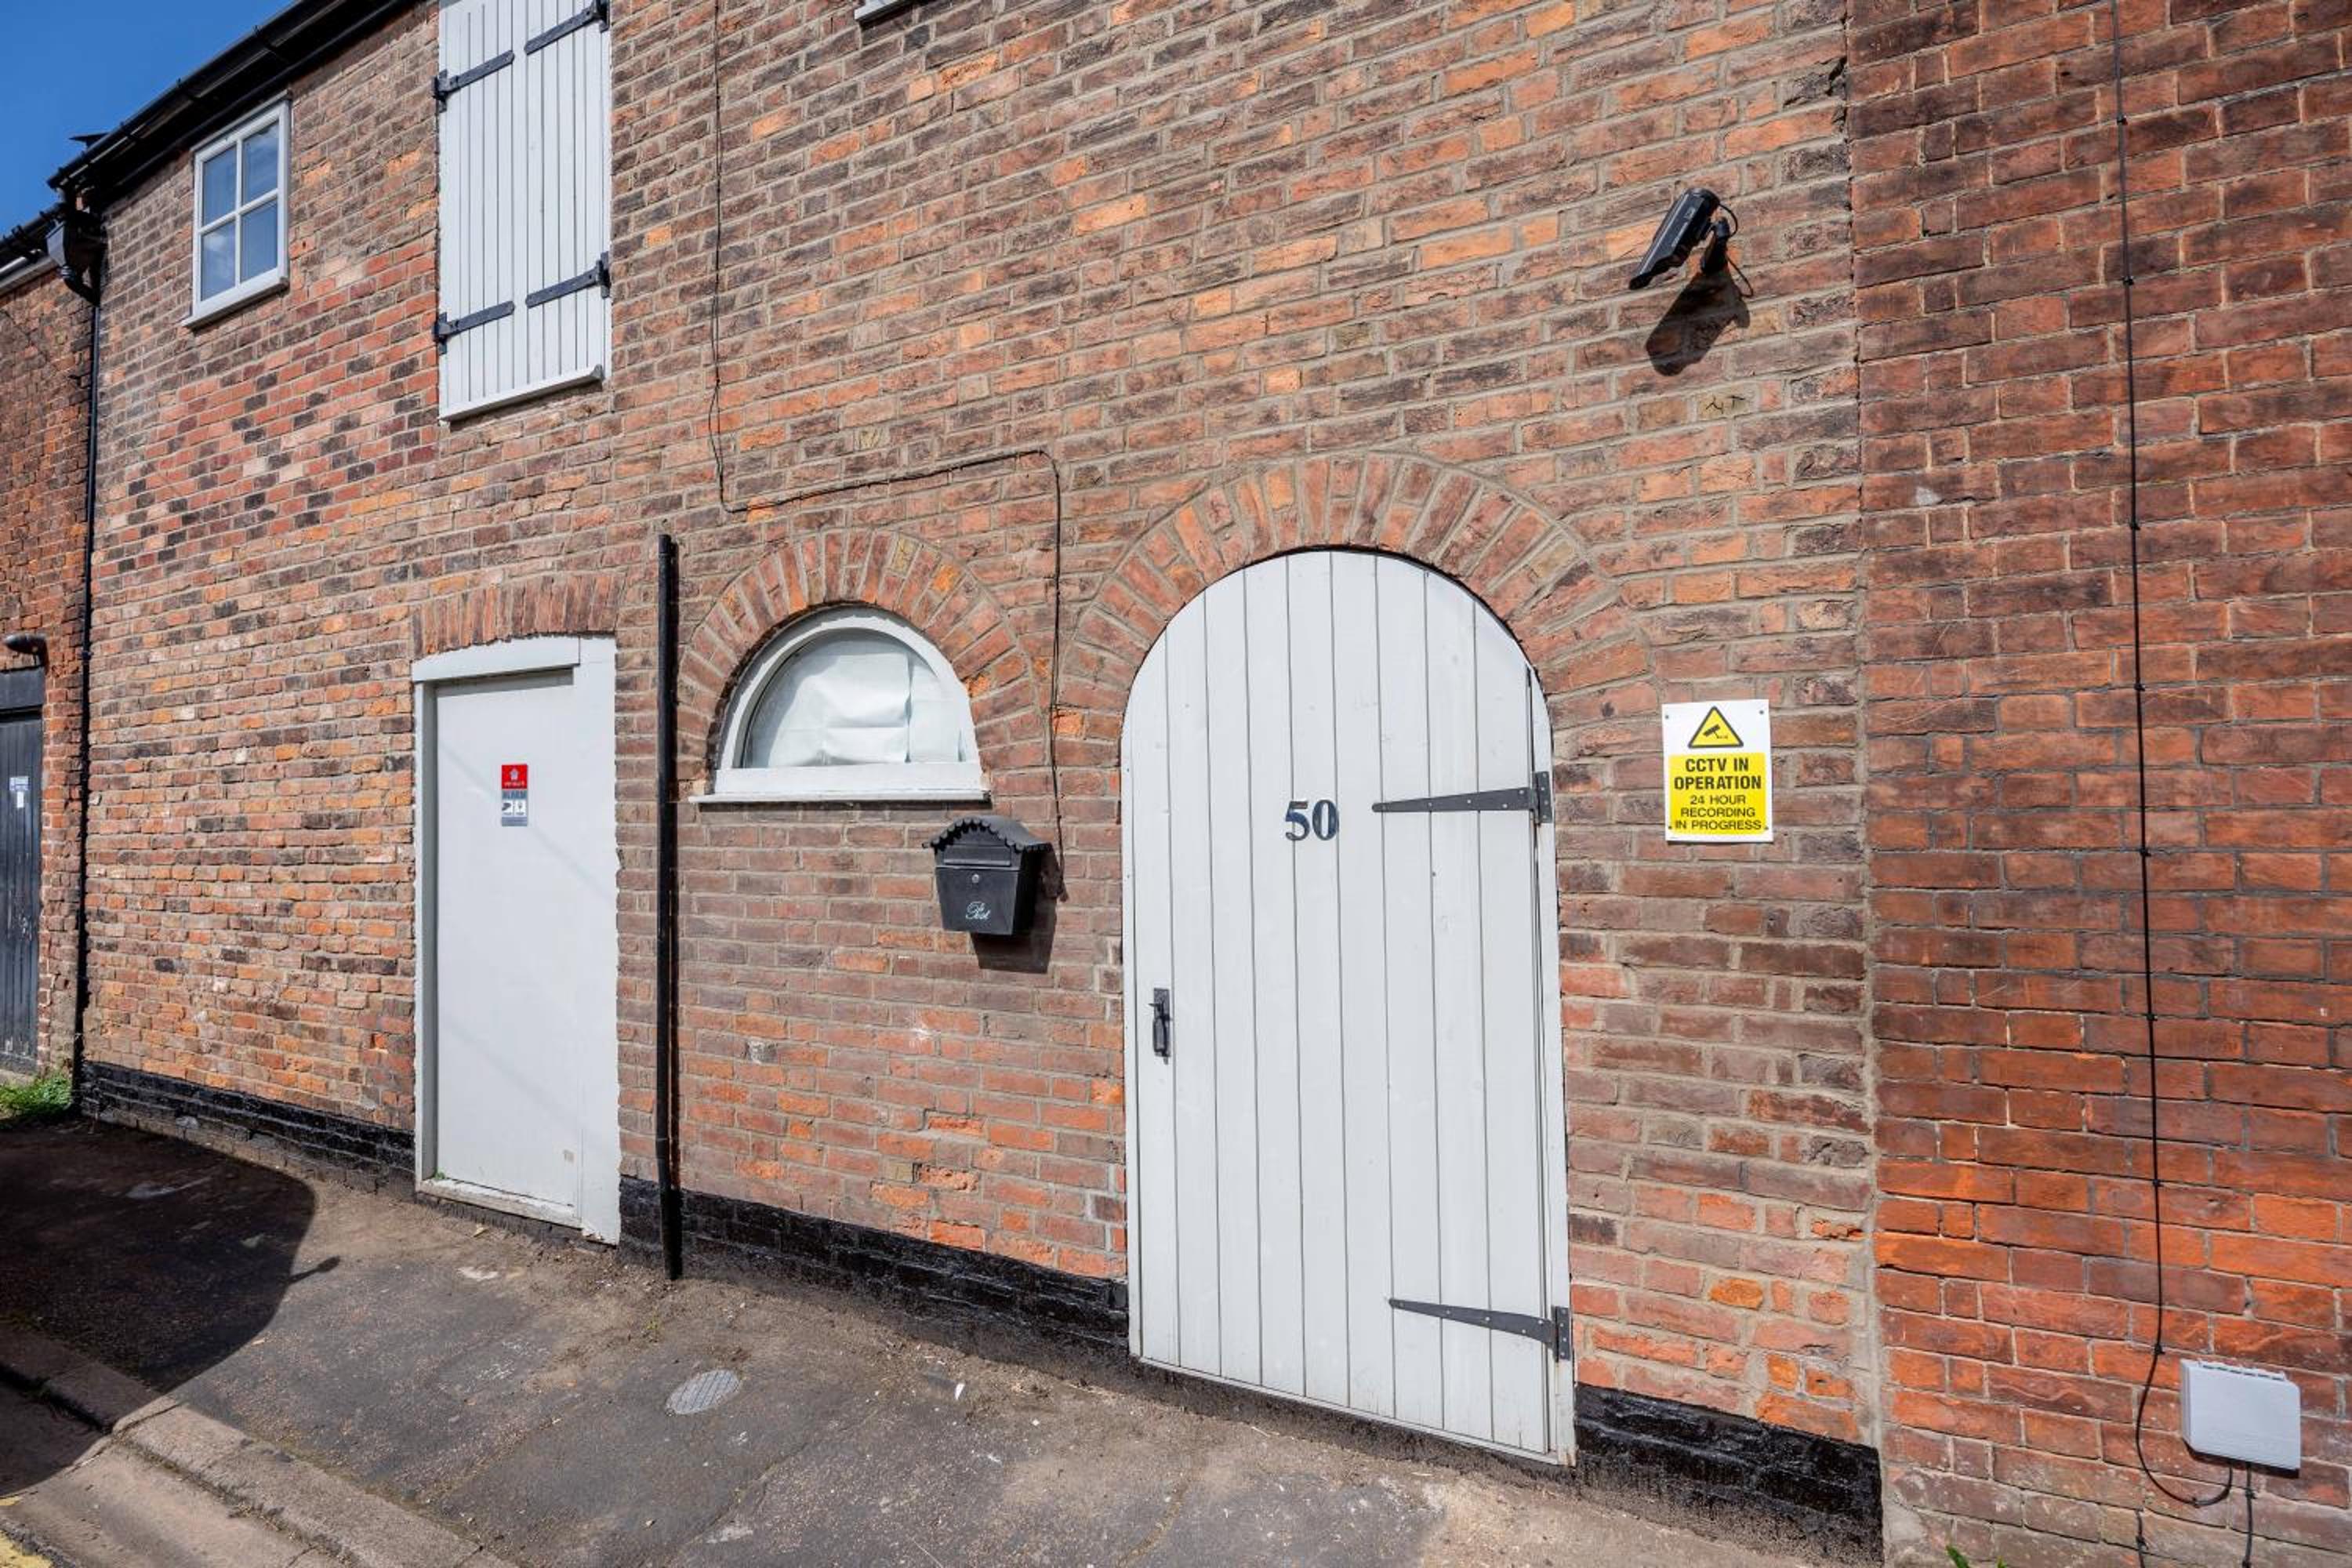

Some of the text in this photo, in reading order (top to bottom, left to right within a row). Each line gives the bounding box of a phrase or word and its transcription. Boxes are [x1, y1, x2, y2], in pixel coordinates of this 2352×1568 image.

[1686, 757, 1749, 772] CCTV IN
[1674, 775, 1762, 790] OPERATION
[1690, 795, 1746, 805] 24 HOUR
[1681, 808, 1755, 818] RECORDING
[1285, 800, 1340, 840] 50
[1675, 820, 1762, 830] IN PROGRESS
